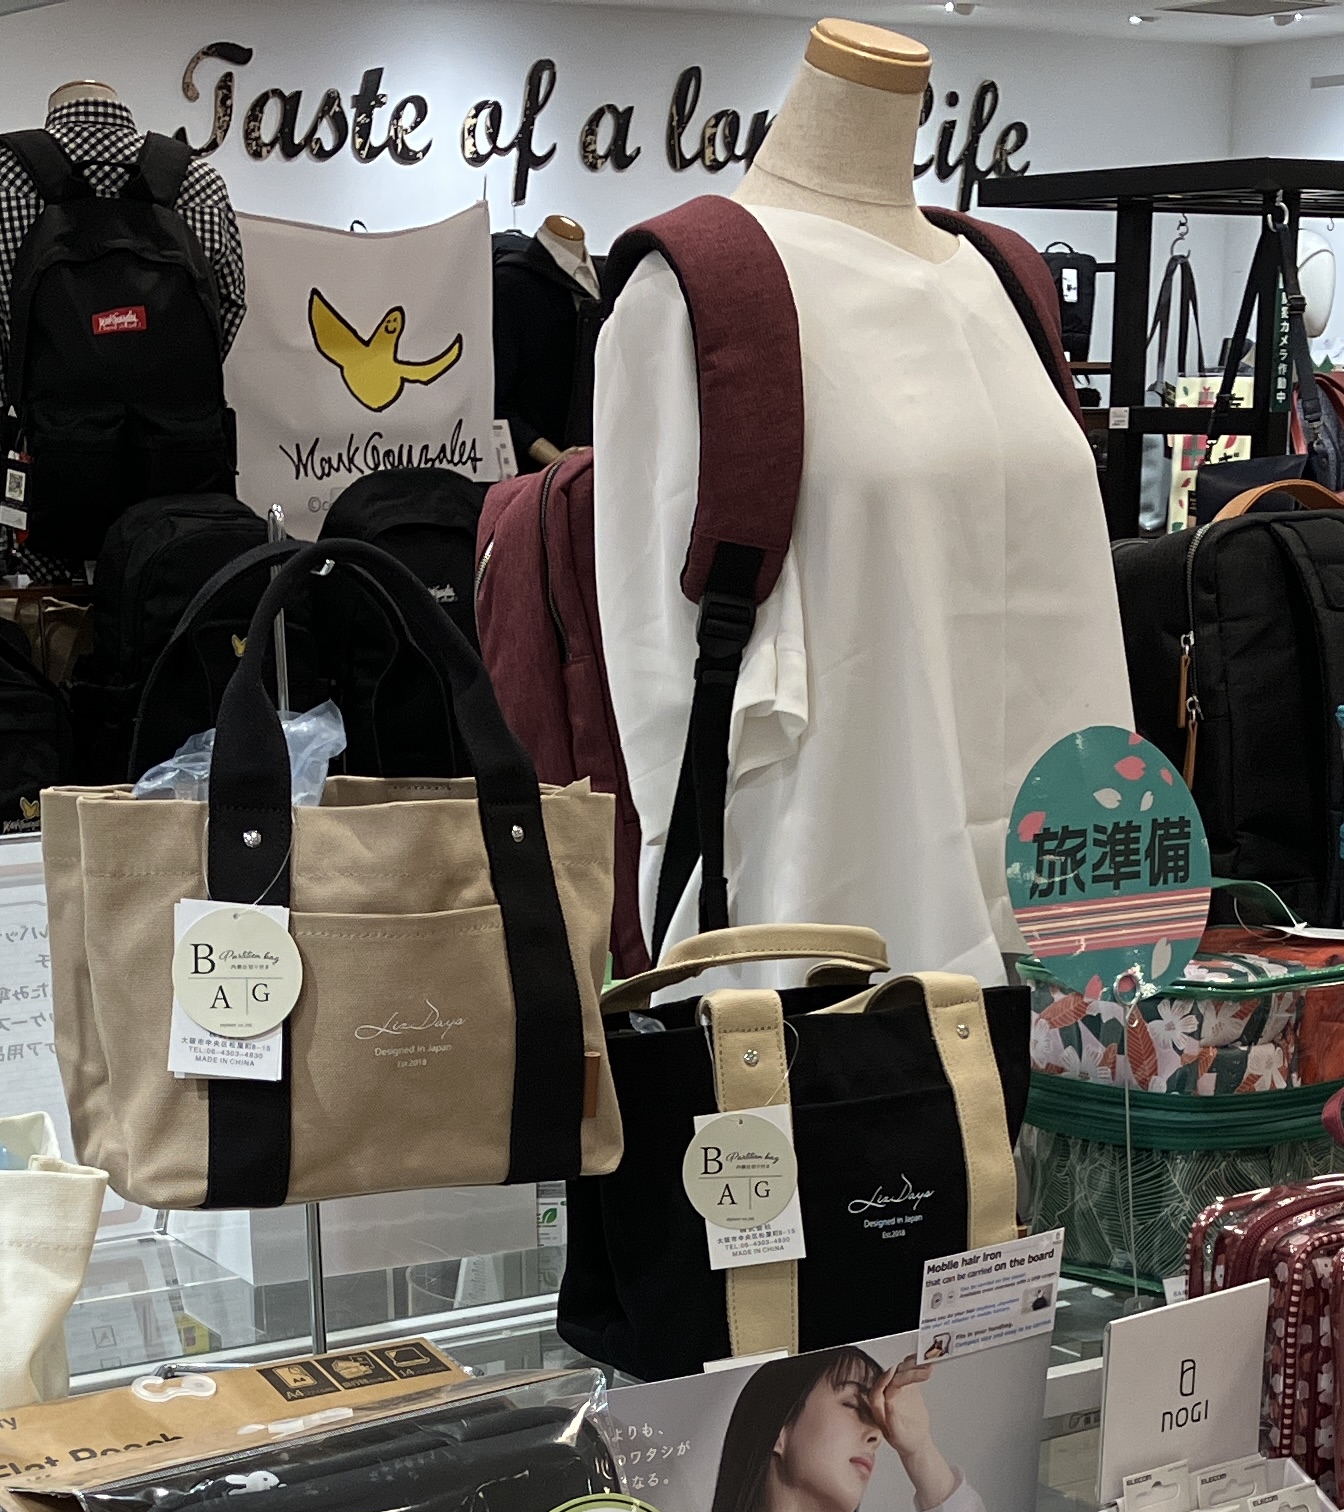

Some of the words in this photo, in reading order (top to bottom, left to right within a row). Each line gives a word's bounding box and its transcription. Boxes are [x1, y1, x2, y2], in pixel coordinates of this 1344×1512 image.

[171, 42, 433, 165] Taste
[462, 58, 558, 205] of
[581, 103, 641, 171] a
[666, 65, 780, 174] lo
[1029, 815, 1192, 900] 旅準備
[189, 943, 216, 975] B
[209, 984, 233, 1009] A
[251, 982, 270, 1003] G
[925, 1278, 942, 1288] that
[942, 1275, 956, 1283] can
[956, 1273, 967, 1281] be
[967, 1266, 993, 1277] carried
[994, 1262, 1007, 1272] on
[1009, 1257, 1026, 1268] the
[1027, 1248, 1055, 1264] board
[926, 1259, 960, 1275] Mobile
[961, 1255, 982, 1266] hair
